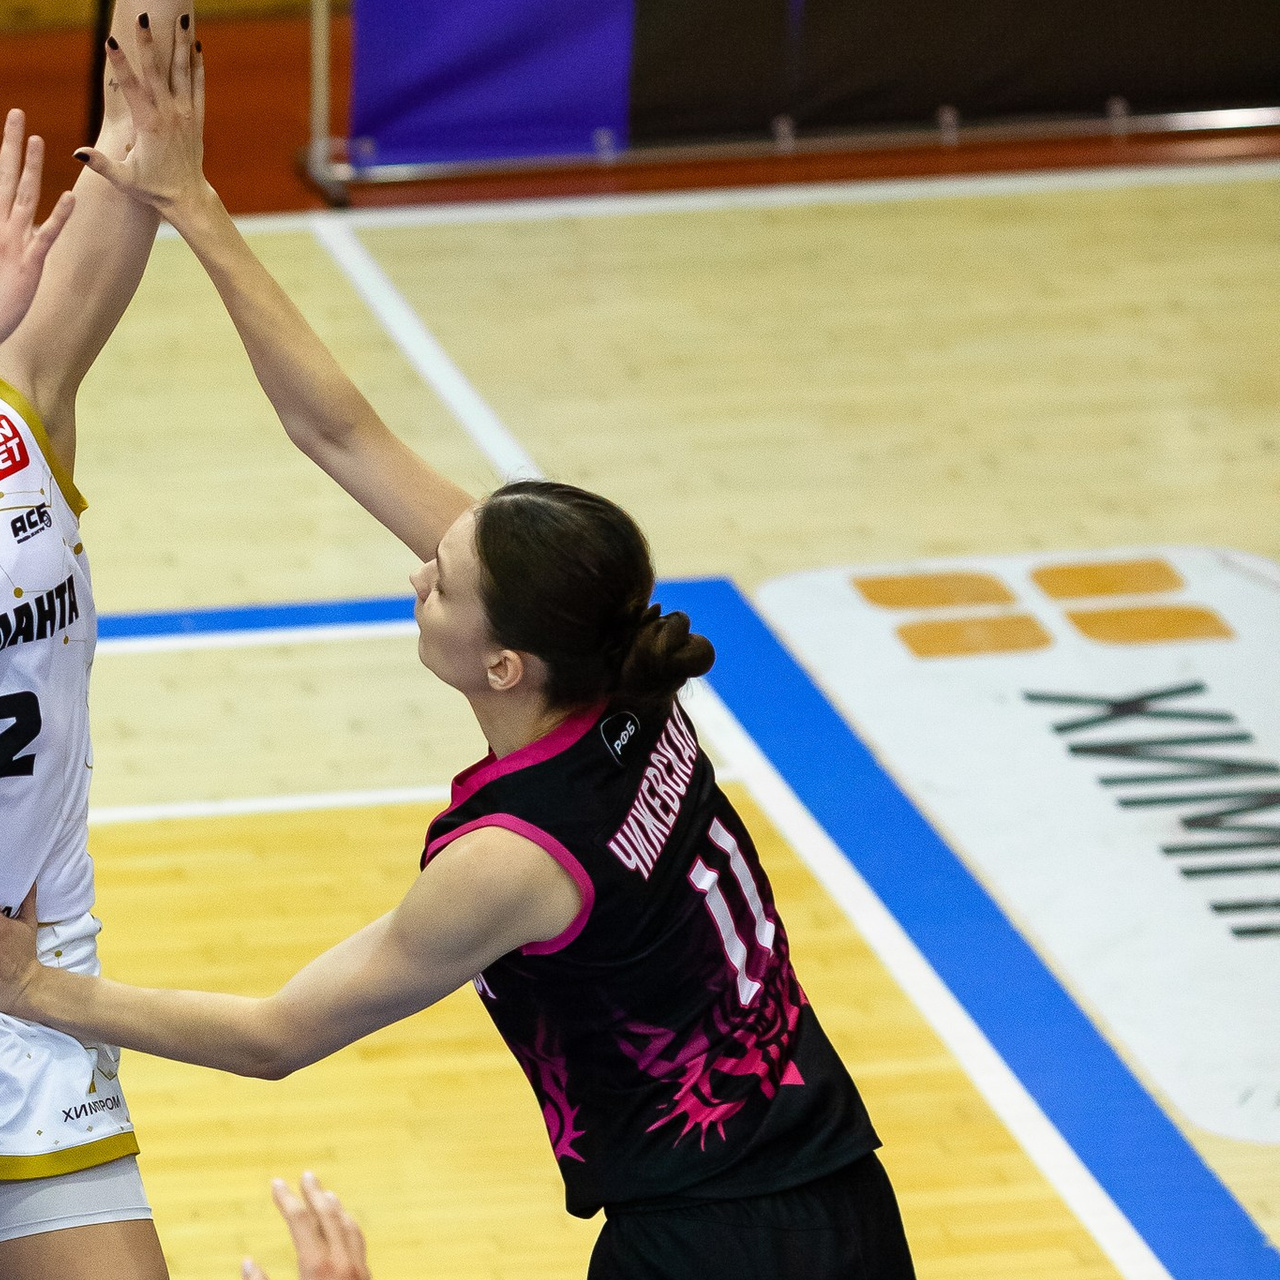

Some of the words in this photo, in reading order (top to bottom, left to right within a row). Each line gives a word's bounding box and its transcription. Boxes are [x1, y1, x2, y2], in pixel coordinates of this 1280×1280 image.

[613, 720, 636, 755] РФБ
[686, 816, 776, 1010] 11
[62, 1095, 121, 1123] ХИМПРОМ
